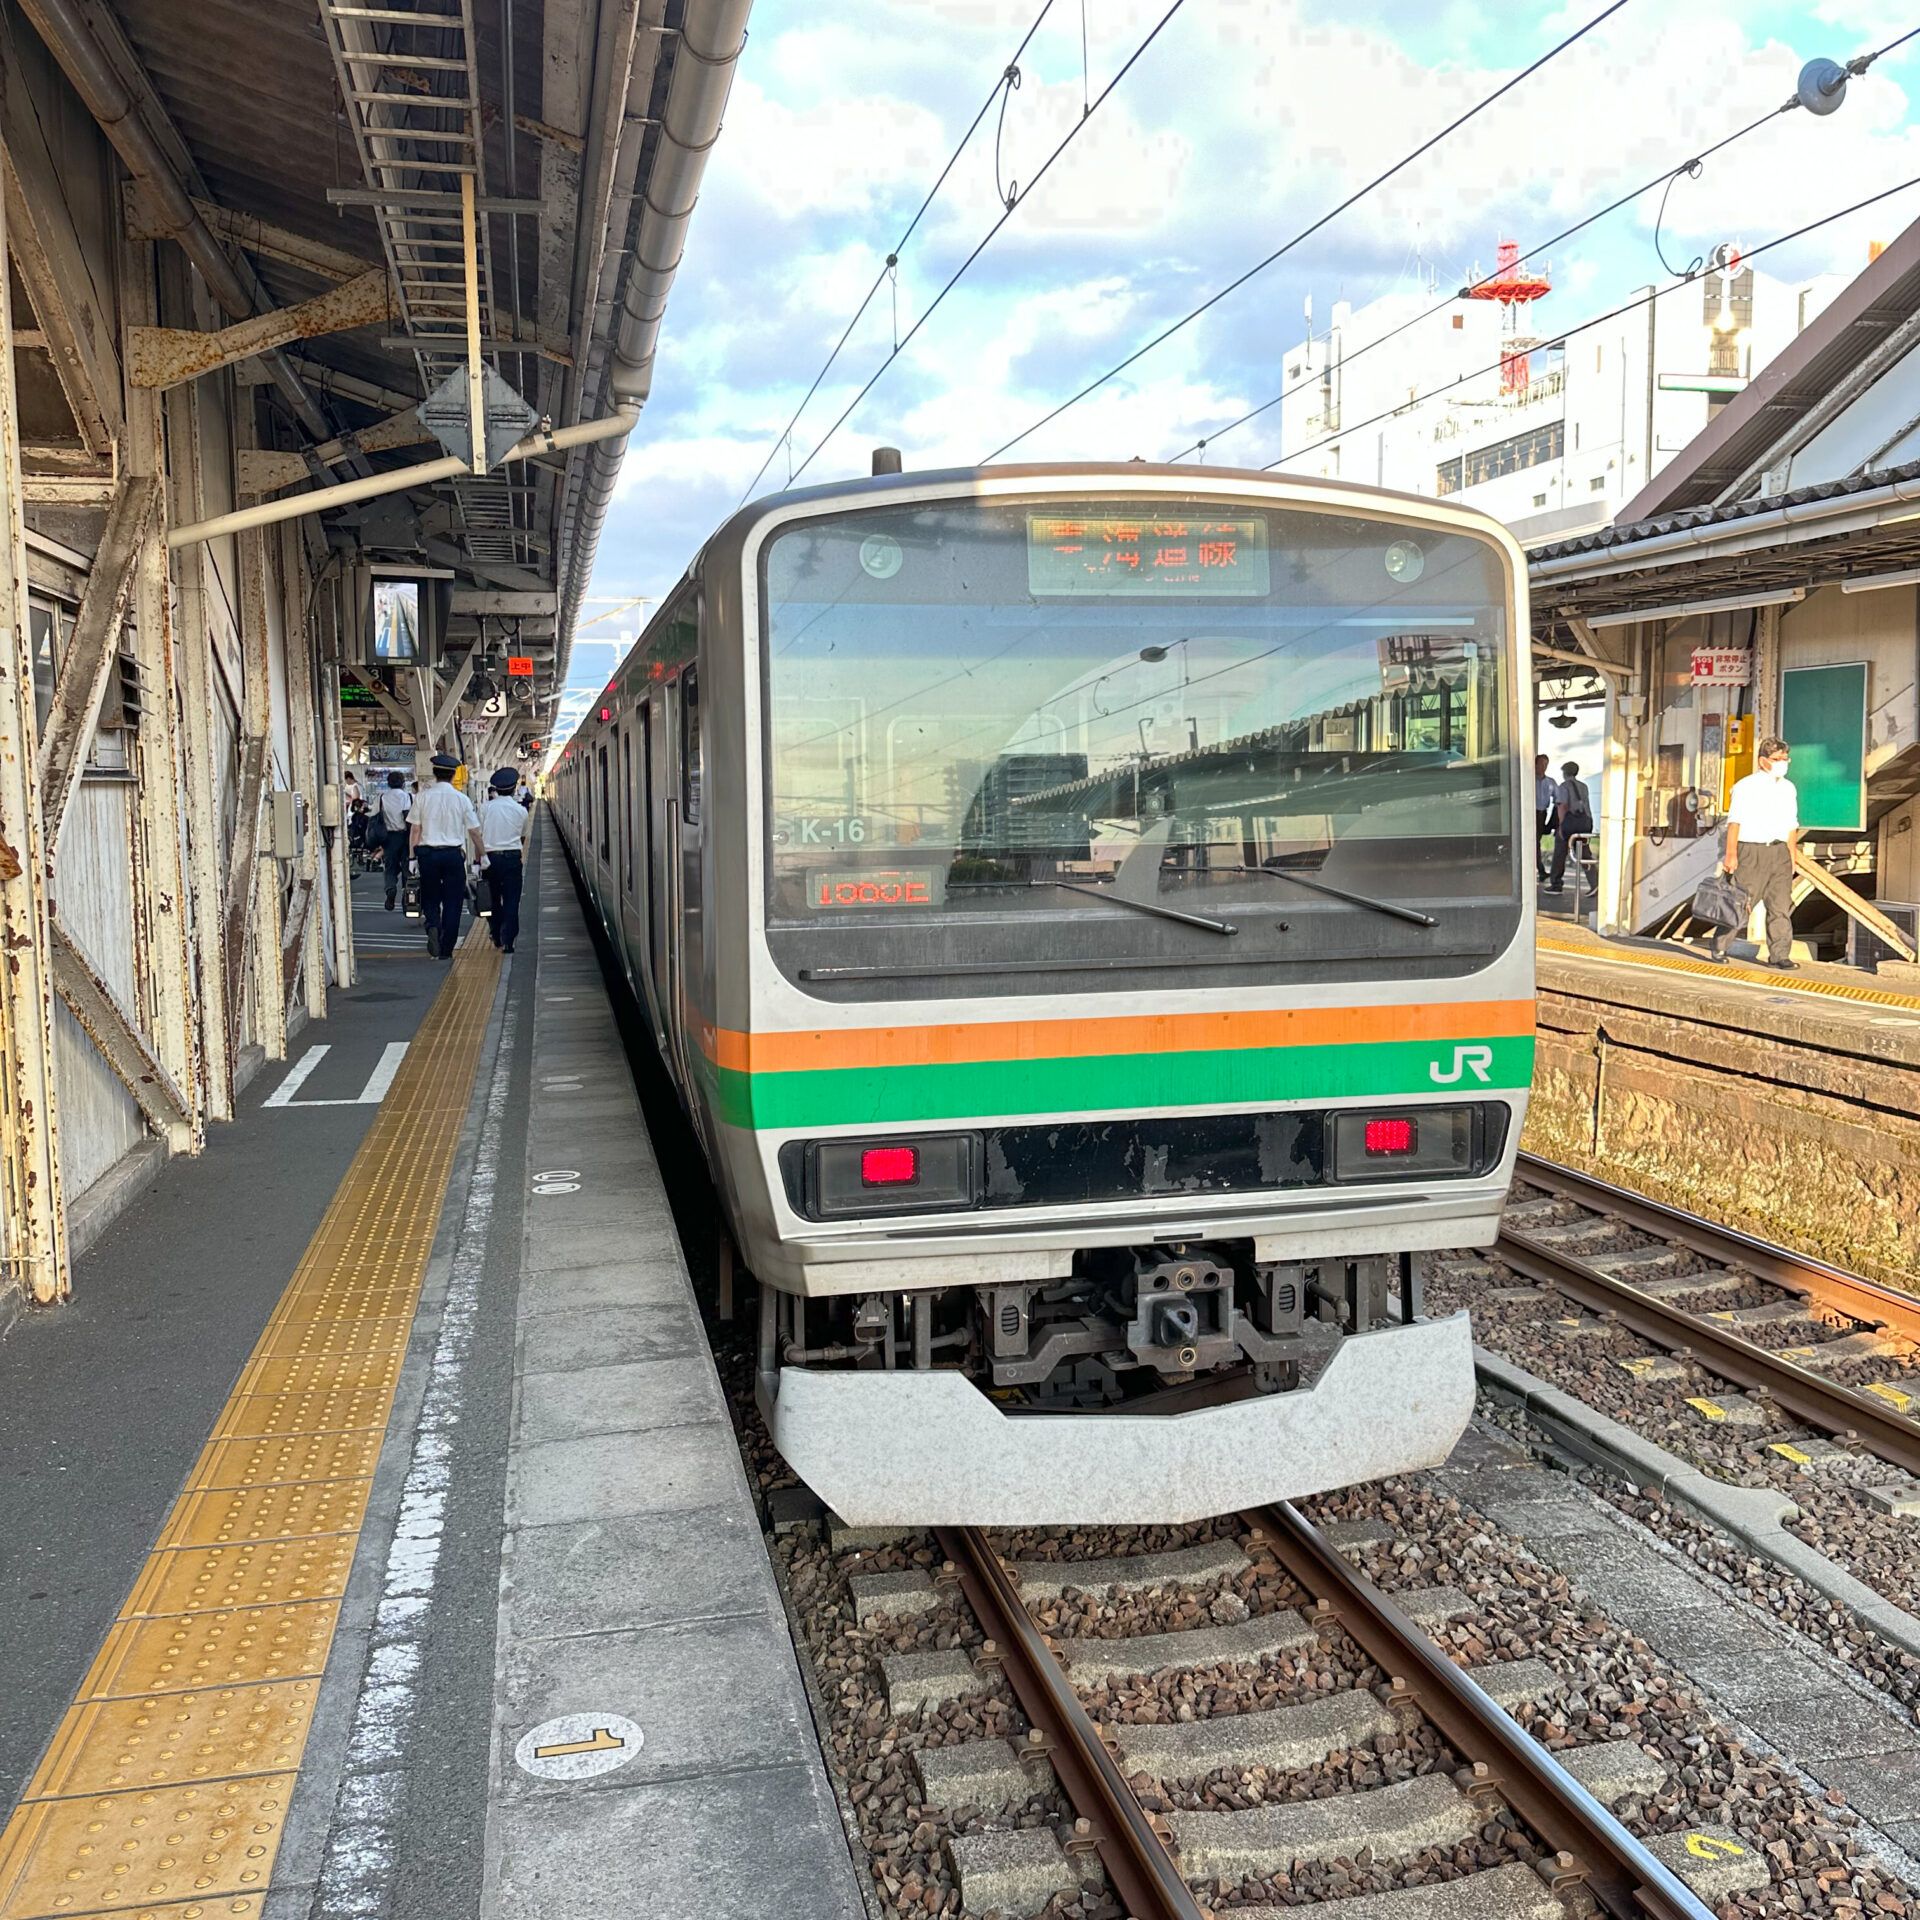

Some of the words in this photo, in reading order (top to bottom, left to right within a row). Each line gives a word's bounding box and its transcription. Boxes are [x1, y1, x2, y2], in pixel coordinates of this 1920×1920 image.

[1696, 656, 1713, 664] SOS
[1715, 654, 1748, 664] 非常停止
[1719, 664, 1744, 673] ボタン
[485, 695, 500, 713] 3
[801, 818, 865, 844] K-16
[1429, 1045, 1493, 1084] JR
[534, 1728, 625, 1758] 1
